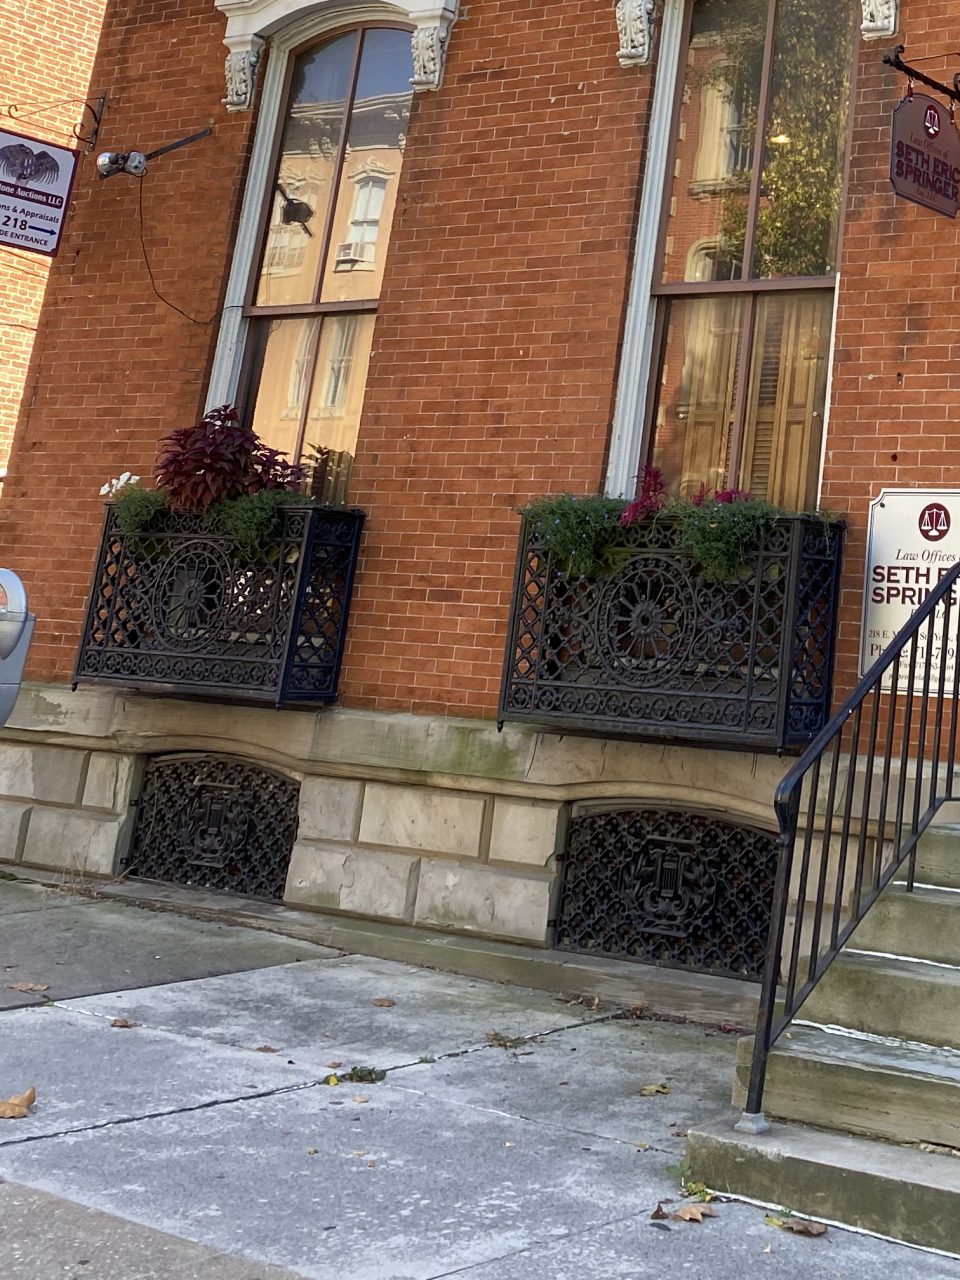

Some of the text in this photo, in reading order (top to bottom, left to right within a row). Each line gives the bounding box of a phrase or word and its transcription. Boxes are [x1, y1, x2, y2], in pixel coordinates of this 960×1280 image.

[896, 140, 960, 185] SETH ERIC
[895, 159, 960, 203] SPRINGER
[0, 183, 62, 206] one Auctions LLC
[2, 215, 28, 231] 218
[19, 208, 60, 224] Appraisals
[10, 231, 49, 247] ENTRANCE
[895, 548, 919, 561] Law
[921, 549, 956, 562] Offices
[871, 565, 931, 585] SETH
[868, 629, 881, 639] 218
[882, 630, 890, 639] E.
